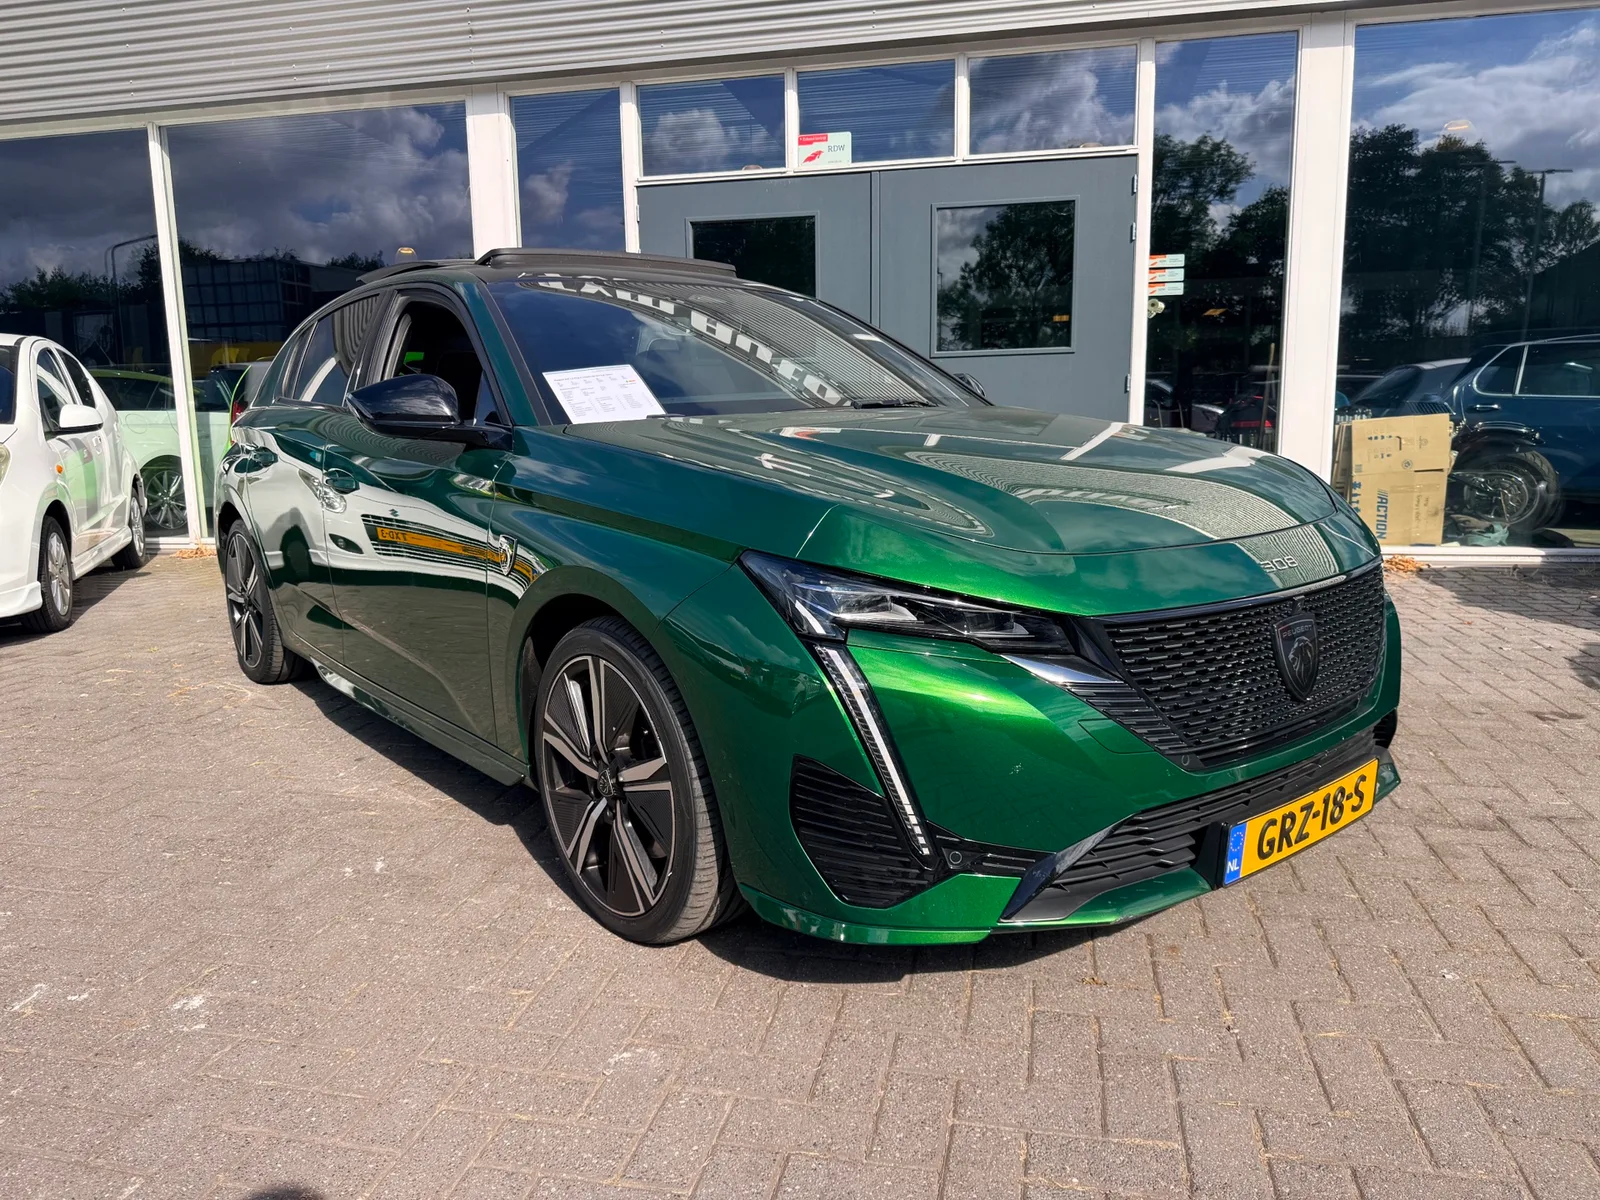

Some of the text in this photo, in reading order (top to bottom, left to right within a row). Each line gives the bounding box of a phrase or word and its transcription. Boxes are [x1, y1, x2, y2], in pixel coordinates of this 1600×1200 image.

[827, 144, 846, 153] RDW
[1375, 497, 1389, 540] ACTION
[1260, 555, 1298, 573] 308
[1282, 624, 1312, 639] PEUGEOT
[1257, 774, 1367, 861] GRZ-18-S
[1227, 858, 1240, 874] NL
